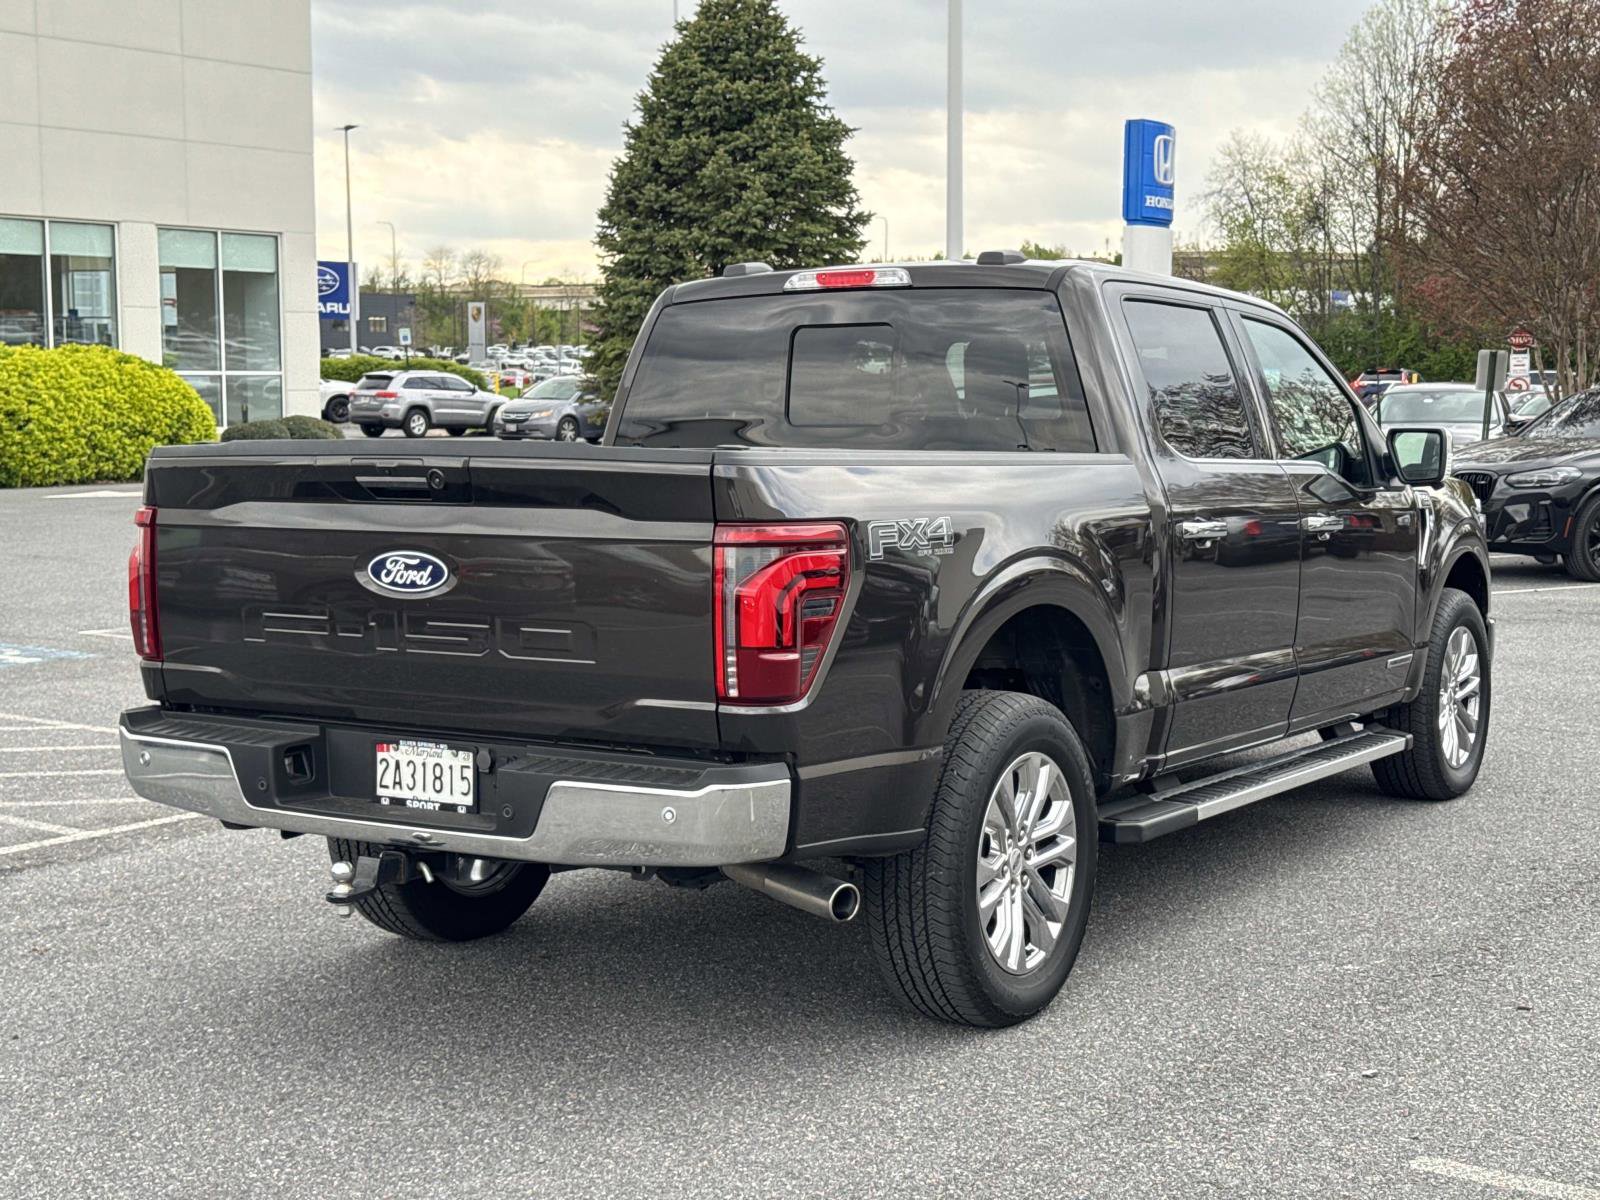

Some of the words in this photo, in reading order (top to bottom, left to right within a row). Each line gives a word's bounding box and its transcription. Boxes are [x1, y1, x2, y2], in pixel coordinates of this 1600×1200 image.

[867, 516, 954, 560] FX4
[381, 556, 433, 586] Ford
[242, 603, 597, 664] F-150
[404, 745, 443, 760] Maryland
[379, 758, 471, 796] 2A31815
[406, 799, 441, 811] SPORT
